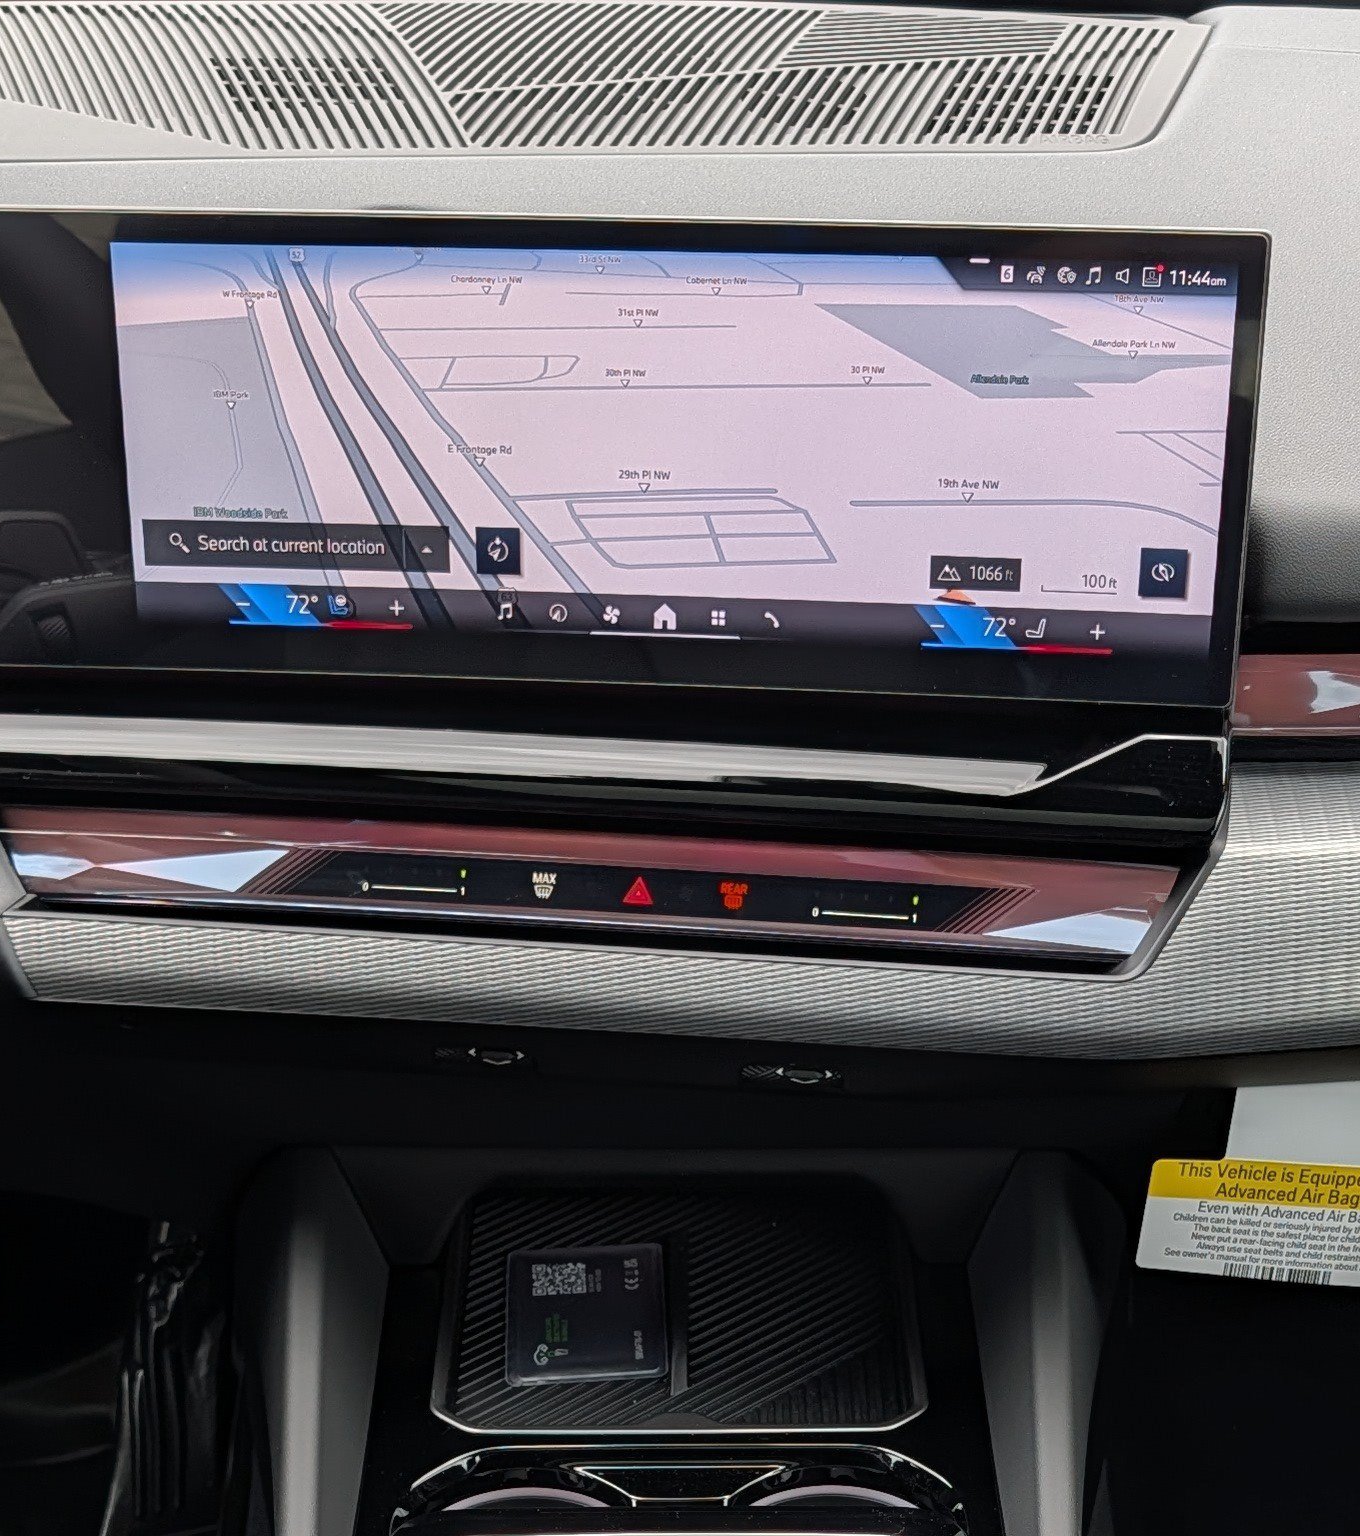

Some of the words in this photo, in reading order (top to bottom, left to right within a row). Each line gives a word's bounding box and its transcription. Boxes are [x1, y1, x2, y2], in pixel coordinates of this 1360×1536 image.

[509, 275, 522, 284] NW
[1170, 269, 1227, 286] 11:44am
[618, 308, 634, 317] 31st
[645, 309, 659, 317] NW
[1161, 341, 1176, 349] NW
[851, 366, 860, 374] 30
[871, 366, 885, 374] NW
[447, 444, 454, 453] E
[456, 445, 498, 456] Frontage
[499, 446, 512, 455] Rd
[619, 469, 640, 479] 29th
[653, 471, 671, 480] NW
[938, 478, 959, 489] 19th
[961, 479, 980, 489] Ave
[982, 480, 1000, 490] NW
[265, 508, 288, 520] Park
[197, 535, 249, 552] Search
[252, 539, 269, 552] at
[271, 539, 324, 554] current
[327, 538, 385, 555] location
[969, 565, 1003, 581] 1066
[1005, 568, 1014, 581] ft
[1082, 574, 1107, 589] 100
[1108, 576, 1118, 589] ft
[532, 871, 557, 885] MAX
[719, 881, 748, 896] REAR
[1178, 1162, 1212, 1178] This
[1217, 1163, 1278, 1182] Vehicle
[1280, 1167, 1294, 1183] is
[1215, 1182, 1298, 1203] Advanced
[1299, 1188, 1325, 1204] Air
[1197, 1200, 1229, 1214] Even
[1232, 1204, 1259, 1217] with
[1261, 1205, 1325, 1221] Advanced
[1326, 1209, 1346, 1223] Air
[1173, 1212, 1209, 1223] Children
[1210, 1216, 1226, 1224] can
[1226, 1216, 1238, 1226] be
[1239, 1218, 1262, 1227] killed
[1262, 1220, 1272, 1228] or
[1273, 1220, 1310, 1232] seriously
[1311, 1223, 1341, 1234] injured
[1342, 1225, 1352, 1235] by
[1194, 1223, 1210, 1232] The
[1211, 1224, 1231, 1234] back
[1232, 1228, 1251, 1236] seat
[1251, 1228, 1259, 1237] is
[1260, 1229, 1275, 1238] the
[1276, 1231, 1302, 1240] safest
[1302, 1232, 1326, 1243] place
[1327, 1234, 1339, 1243] for
[1191, 1232, 1217, 1242] Never
[1217, 1235, 1232, 1244] put
[1239, 1237, 1285, 1249] rear-facing
[1286, 1241, 1307, 1250] child
[1308, 1243, 1326, 1251] seat
[1327, 1244, 1336, 1252] in
[1336, 1244, 1351, 1253] the
[1196, 1241, 1226, 1252] Always
[1243, 1247, 1262, 1255] seat
[1262, 1248, 1284, 1257] belts
[1302, 1251, 1323, 1260] child
[1164, 1247, 1181, 1257] See
[1181, 1251, 1215, 1260] owner's
[1216, 1254, 1248, 1263] manual
[1248, 1255, 1261, 1264] for
[1261, 1258, 1284, 1266] more
[1284, 1260, 1333, 1270] information
[1334, 1263, 1358, 1272] about
